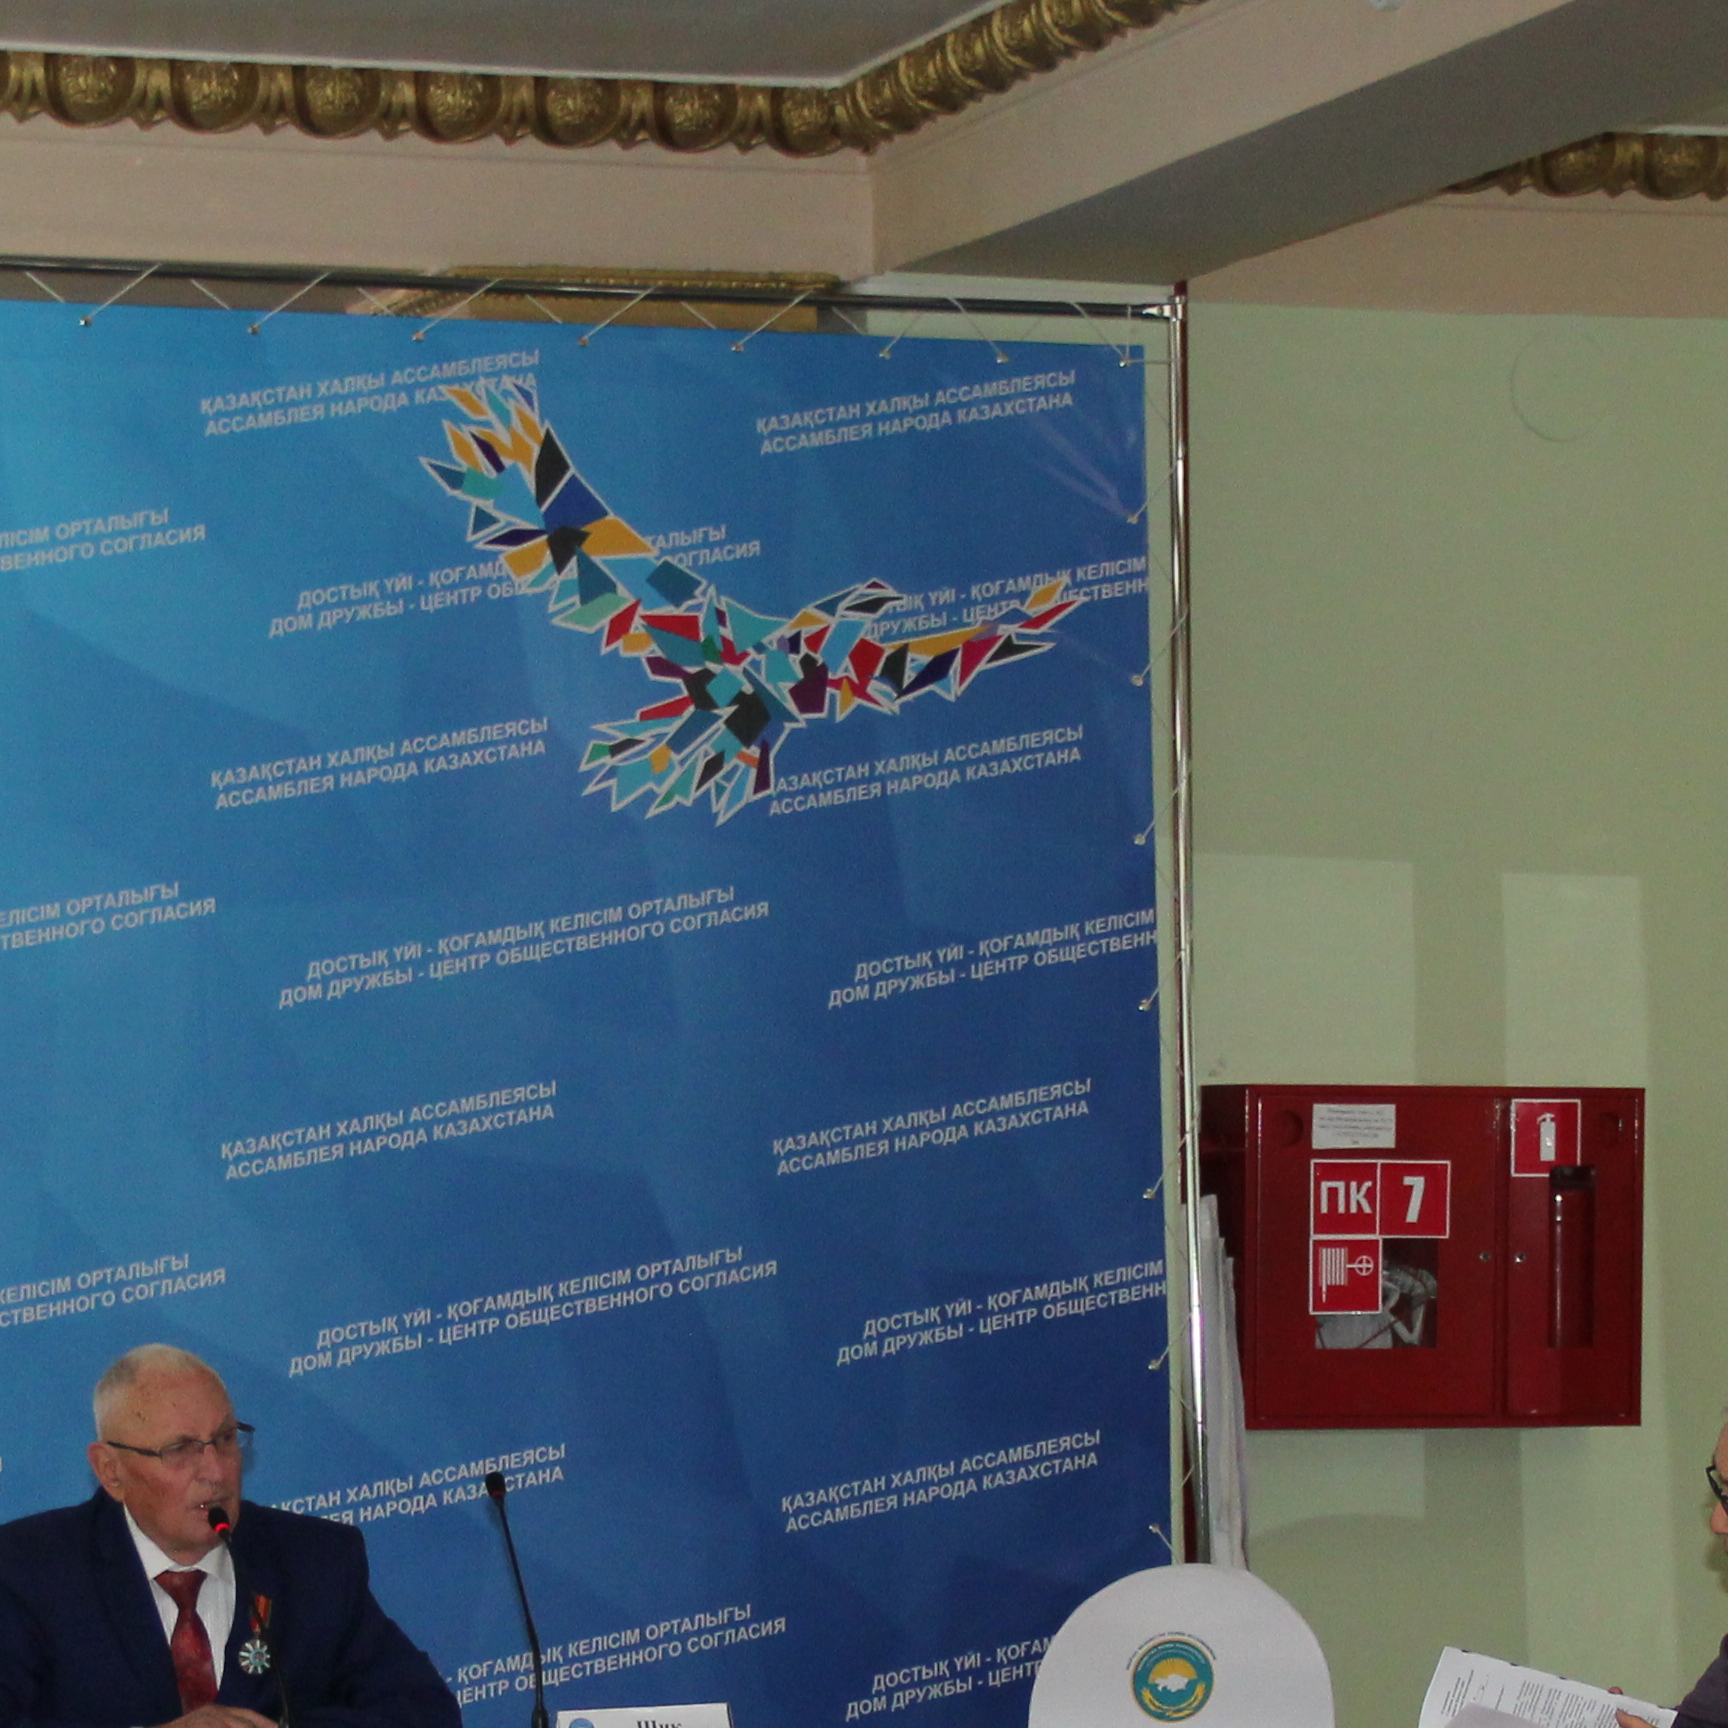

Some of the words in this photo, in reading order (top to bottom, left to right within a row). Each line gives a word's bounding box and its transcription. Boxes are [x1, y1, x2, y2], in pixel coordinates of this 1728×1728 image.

[756, 403, 861, 435] ҚАЗАҚСТАН
[866, 393, 929, 415] ХАЛҚЫ
[935, 370, 1076, 404] АССАМБЛЕЯСЫ
[760, 423, 872, 455] АССАМБЛЕЯ
[878, 411, 952, 435] НАРОДА
[957, 392, 1073, 423] КАЗАХСТАНА
[211, 755, 322, 790] ҚАЗАҚСТАН
[327, 743, 394, 766] ХАЛҚЫ
[401, 717, 548, 754] АССАМБЛЕЯСЫ
[215, 775, 334, 810] АССАМБЛЕЯ
[340, 762, 418, 787] НАРОДА
[424, 739, 545, 773] КАЗАХСТАНА
[111, 897, 216, 930] СОГЛАСИЯ
[306, 950, 389, 981] ДОСТЫҚ
[550, 906, 622, 932] КЕЛІСІМ
[854, 951, 932, 982] ДОСТЫҚ
[1085, 909, 1154, 933] КЕЛІСІМ
[278, 983, 323, 1009] ДОМ
[326, 968, 413, 1000] ДРУЖБЫ
[429, 953, 490, 979] ЦЕНТР
[496, 921, 664, 965] ОБЩЕСТВЕННОГО
[670, 901, 769, 934] СОГЛАСИЯ
[828, 984, 869, 1009] ДОМ
[874, 969, 955, 1000] ДРУЖБЫ
[971, 955, 1029, 980] ЦЕНТР
[221, 1124, 331, 1161] ҚАЗАҚСТАН
[337, 1110, 403, 1136] ХАЛҚЫ
[410, 1080, 557, 1121] АССАМБЛЕЯСЫ
[226, 1144, 344, 1180] АССАМБЛЕЯ
[350, 1129, 428, 1156] НАРОДА
[433, 1103, 554, 1140] КАЗАХСТАНА
[773, 1121, 877, 1156] ҚАЗАҚСТАН
[883, 1106, 946, 1132] ХАЛҚЫ
[952, 1078, 1091, 1118] АССАМБЛЕЯСЫ
[777, 1139, 889, 1175] АССАМБЛЕЯ
[895, 1125, 968, 1152] НАРОДА
[974, 1100, 1089, 1136] КАЗАХСТАНА
[1320, 1180, 1373, 1214] ПК
[1403, 1176, 1426, 1223] 7
[121, 1267, 226, 1303] СОГЛАСИЯ
[288, 1351, 332, 1378] ДОМ
[337, 1333, 422, 1367] ДРУЖБЫ
[439, 1318, 499, 1345] ЦЕНТР
[505, 1282, 673, 1329] ОБЩЕСТВЕННОГО
[678, 1260, 777, 1294] СОГЛАСИЯ
[317, 1316, 398, 1350] ДОСТЫҚ
[558, 1268, 631, 1296] КЕЛІСІМ
[863, 1307, 940, 1339] ДОСТЫҚ
[1094, 1259, 1163, 1286] КЕЛІСІМ
[837, 1341, 877, 1366] ДОМ
[882, 1323, 963, 1357] ДРУЖБЫ
[979, 1308, 1037, 1335] ЦЕНТР
[782, 1476, 885, 1514] ҚАЗАҚСТАН
[891, 1461, 954, 1488] ХАЛҚЫ
[960, 1430, 1100, 1473] АССАМБЛЕЯСЫ
[786, 1495, 897, 1533] АССАМБЛЕЯ
[903, 1478, 977, 1506] НАРОДА
[983, 1452, 1098, 1490] КАЗАХСТАНА
